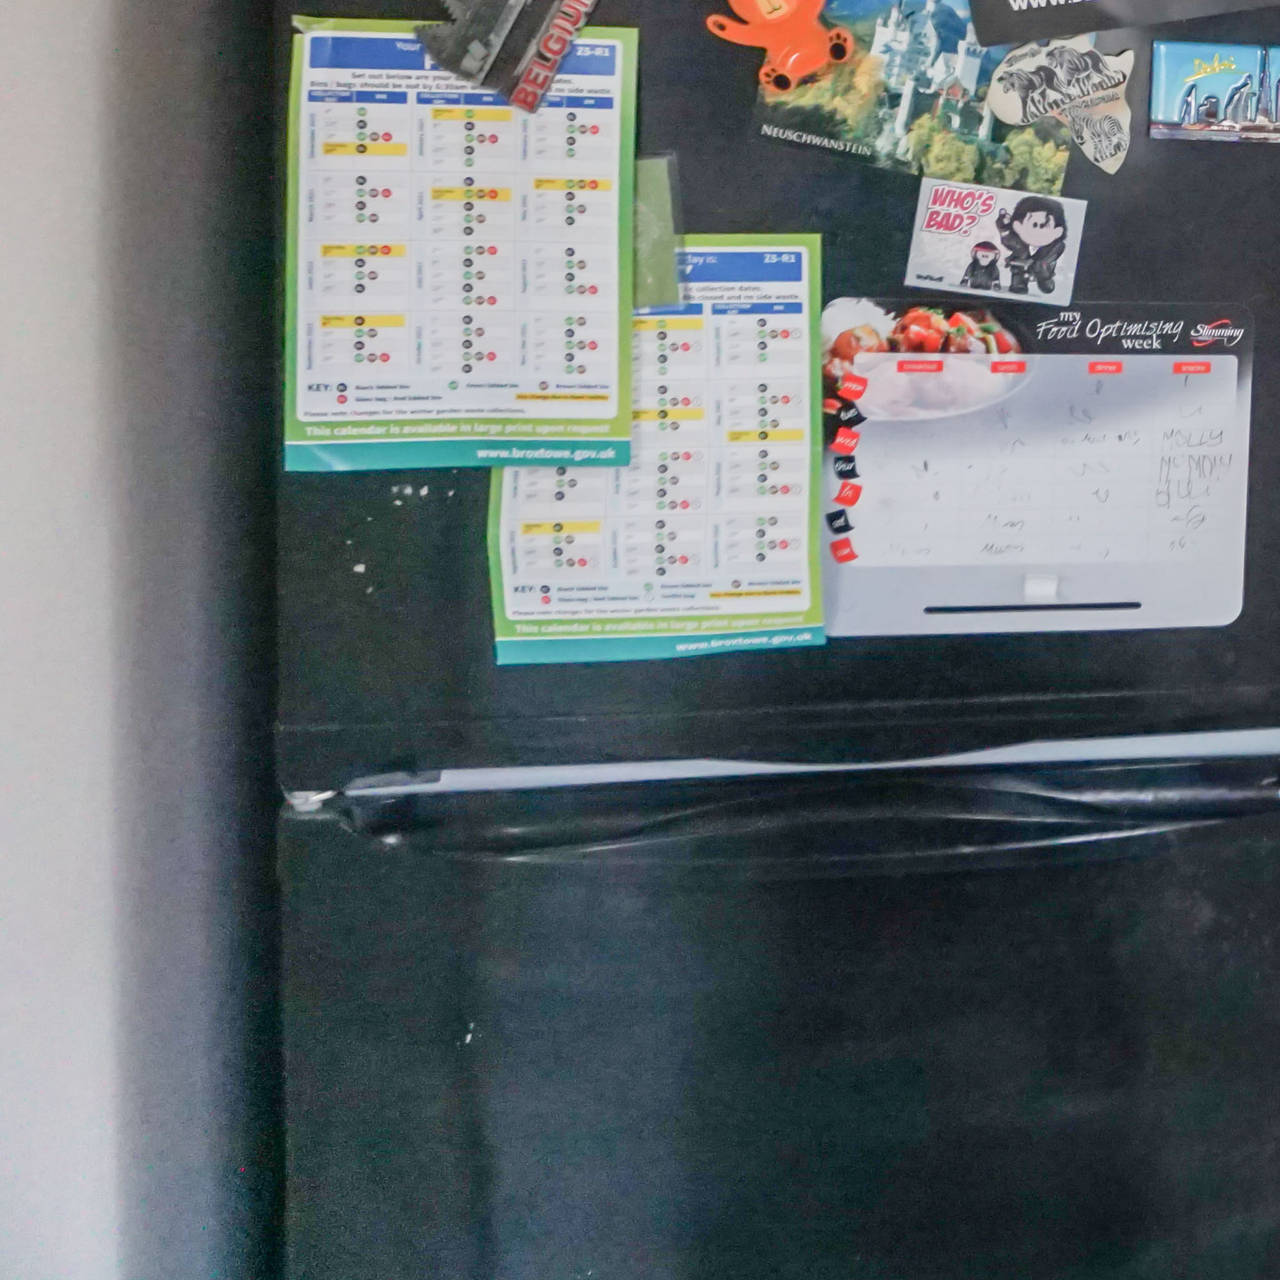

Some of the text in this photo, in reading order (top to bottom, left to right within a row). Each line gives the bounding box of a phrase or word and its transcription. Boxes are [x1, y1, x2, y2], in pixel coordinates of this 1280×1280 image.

[928, 184, 998, 216] WHO'S
[922, 209, 979, 236] BAD?
[1059, 311, 1082, 325] my
[1035, 318, 1246, 348] Food Optimising Slimming
[1121, 333, 1163, 350] week
[305, 425, 332, 437] This
[333, 423, 387, 437] calendar
[402, 422, 458, 435] available
[473, 422, 503, 434] large
[504, 422, 534, 434] print
[476, 447, 617, 461] www.broxtowe.gov.uk
